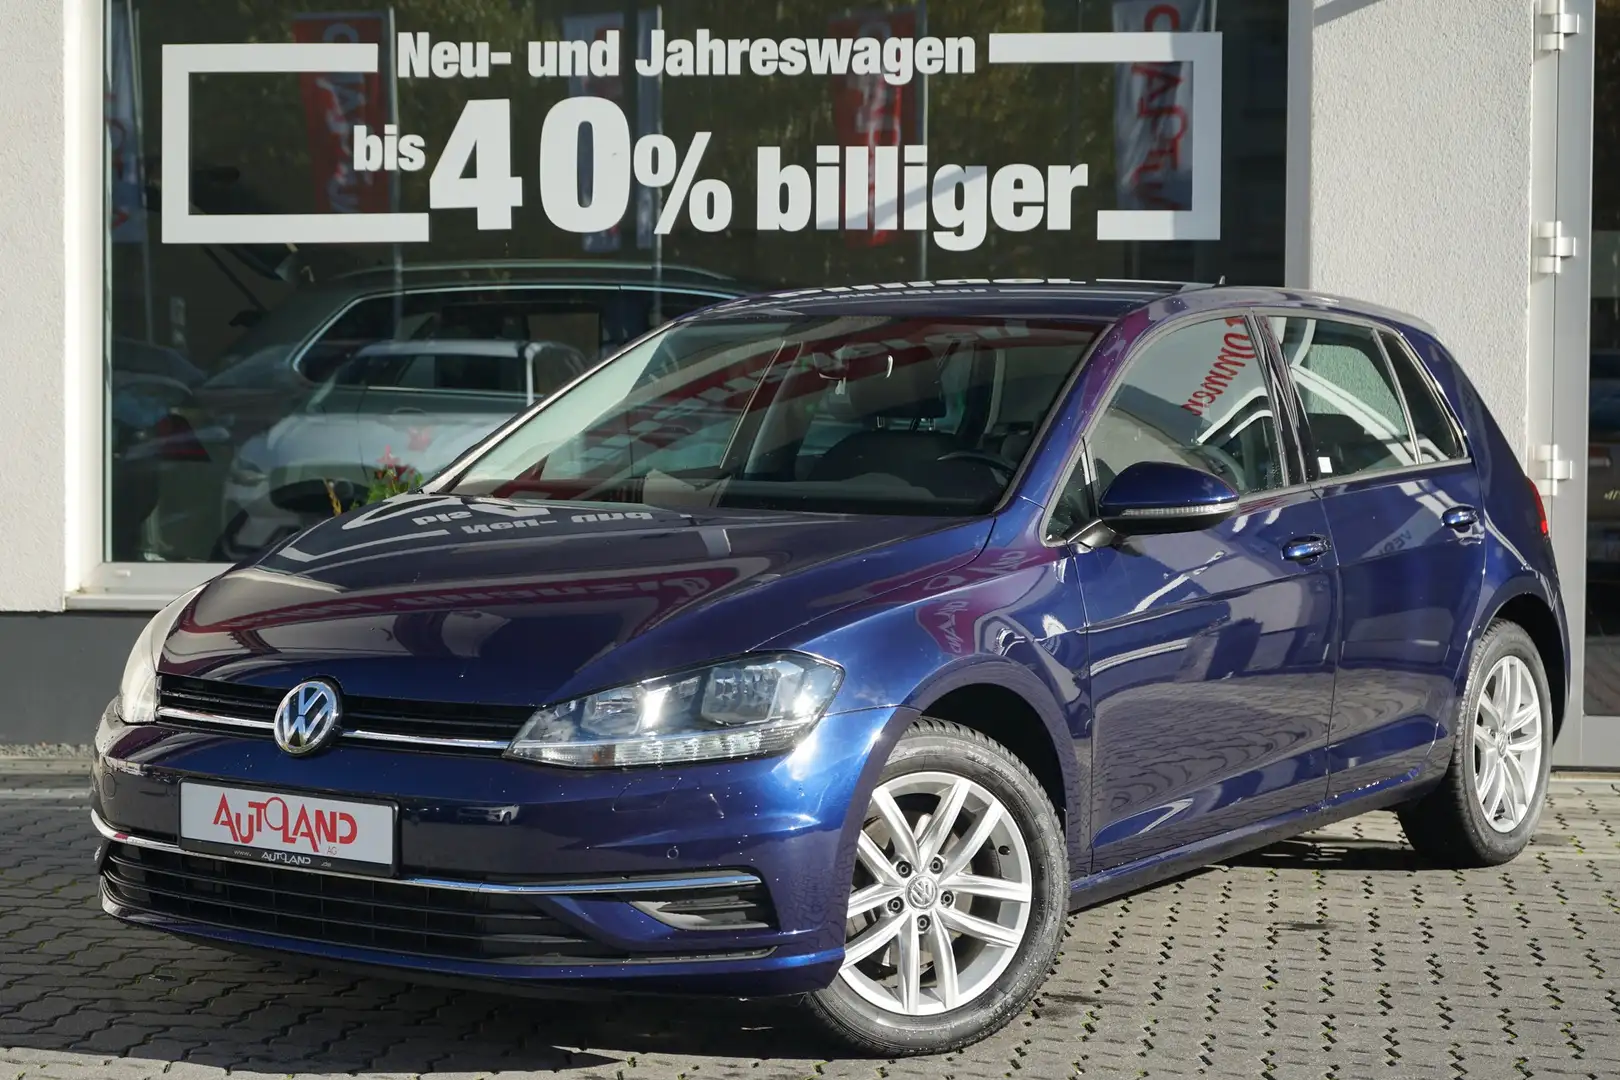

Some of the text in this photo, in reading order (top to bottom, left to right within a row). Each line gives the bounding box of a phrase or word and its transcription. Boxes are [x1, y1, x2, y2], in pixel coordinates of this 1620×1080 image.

[397, 28, 976, 86] Neu- und Jahreswagen
[353, 124, 426, 172] bis
[429, 96, 733, 234] 40%
[756, 144, 1089, 252] billiger
[212, 792, 358, 853] AUTOLAND
[326, 846, 337, 856] AG
[261, 851, 311, 865] AUTOLAND
